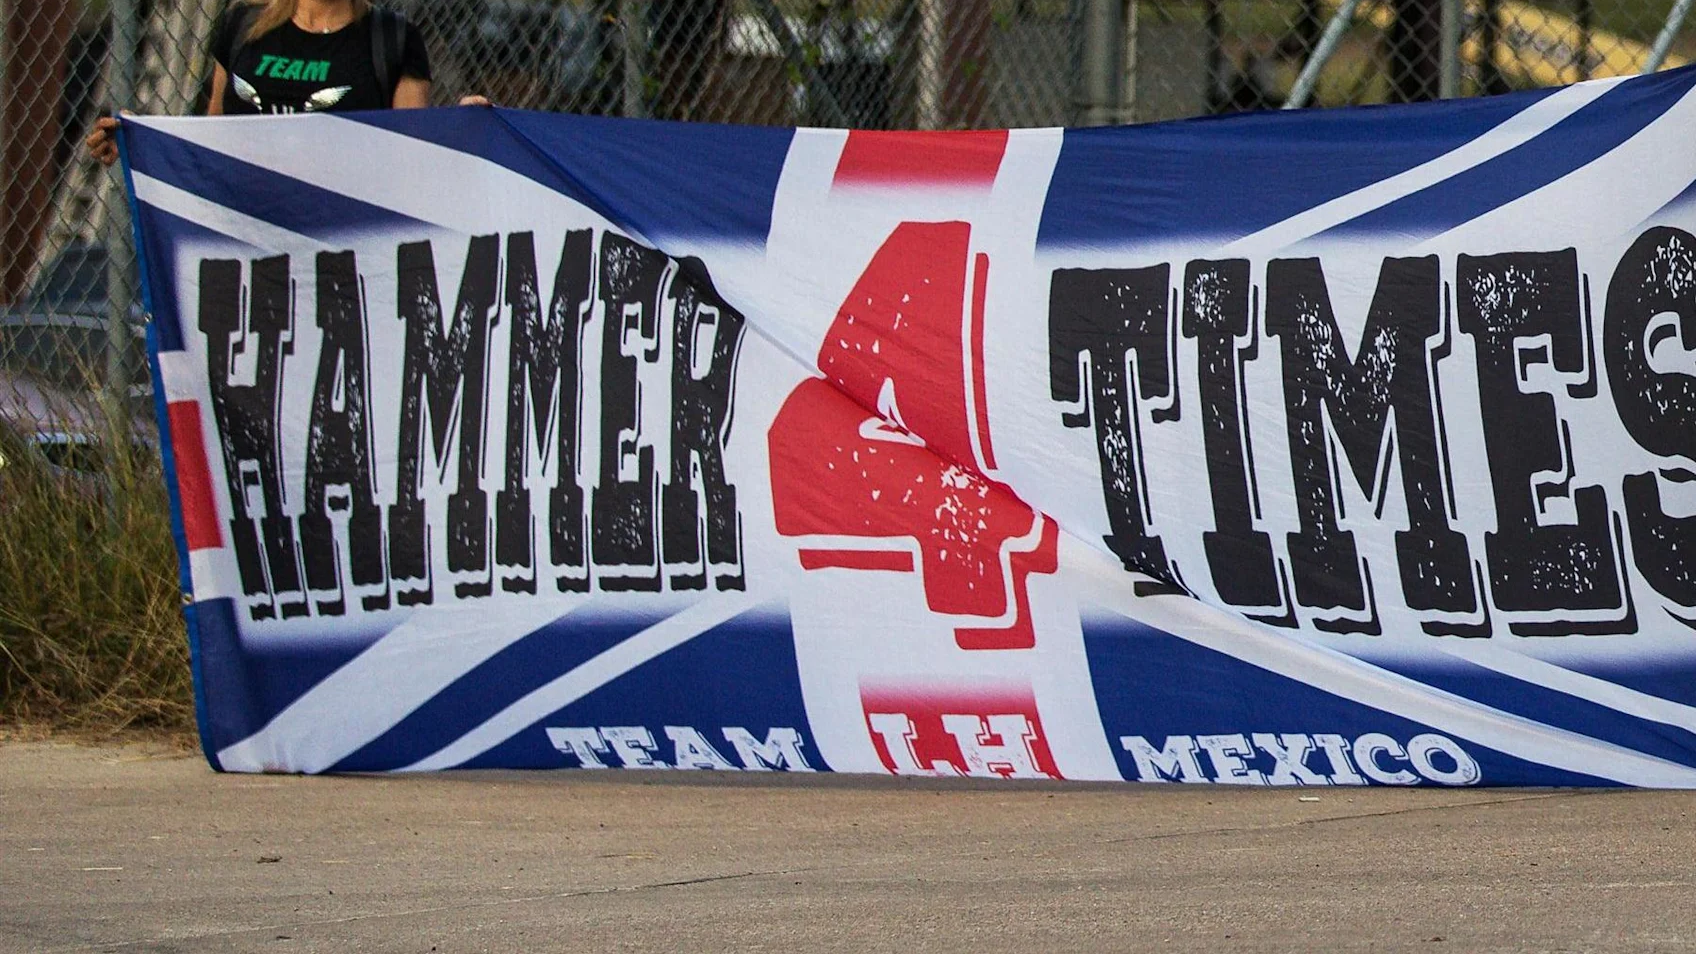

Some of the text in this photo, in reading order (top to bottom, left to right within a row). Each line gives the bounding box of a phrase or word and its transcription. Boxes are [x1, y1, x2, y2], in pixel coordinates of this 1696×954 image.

[255, 54, 331, 82] TEAM
[198, 228, 747, 621] HAMMER
[768, 220, 1058, 650] 4
[545, 712, 1482, 786] TEAM LH MEXICO
